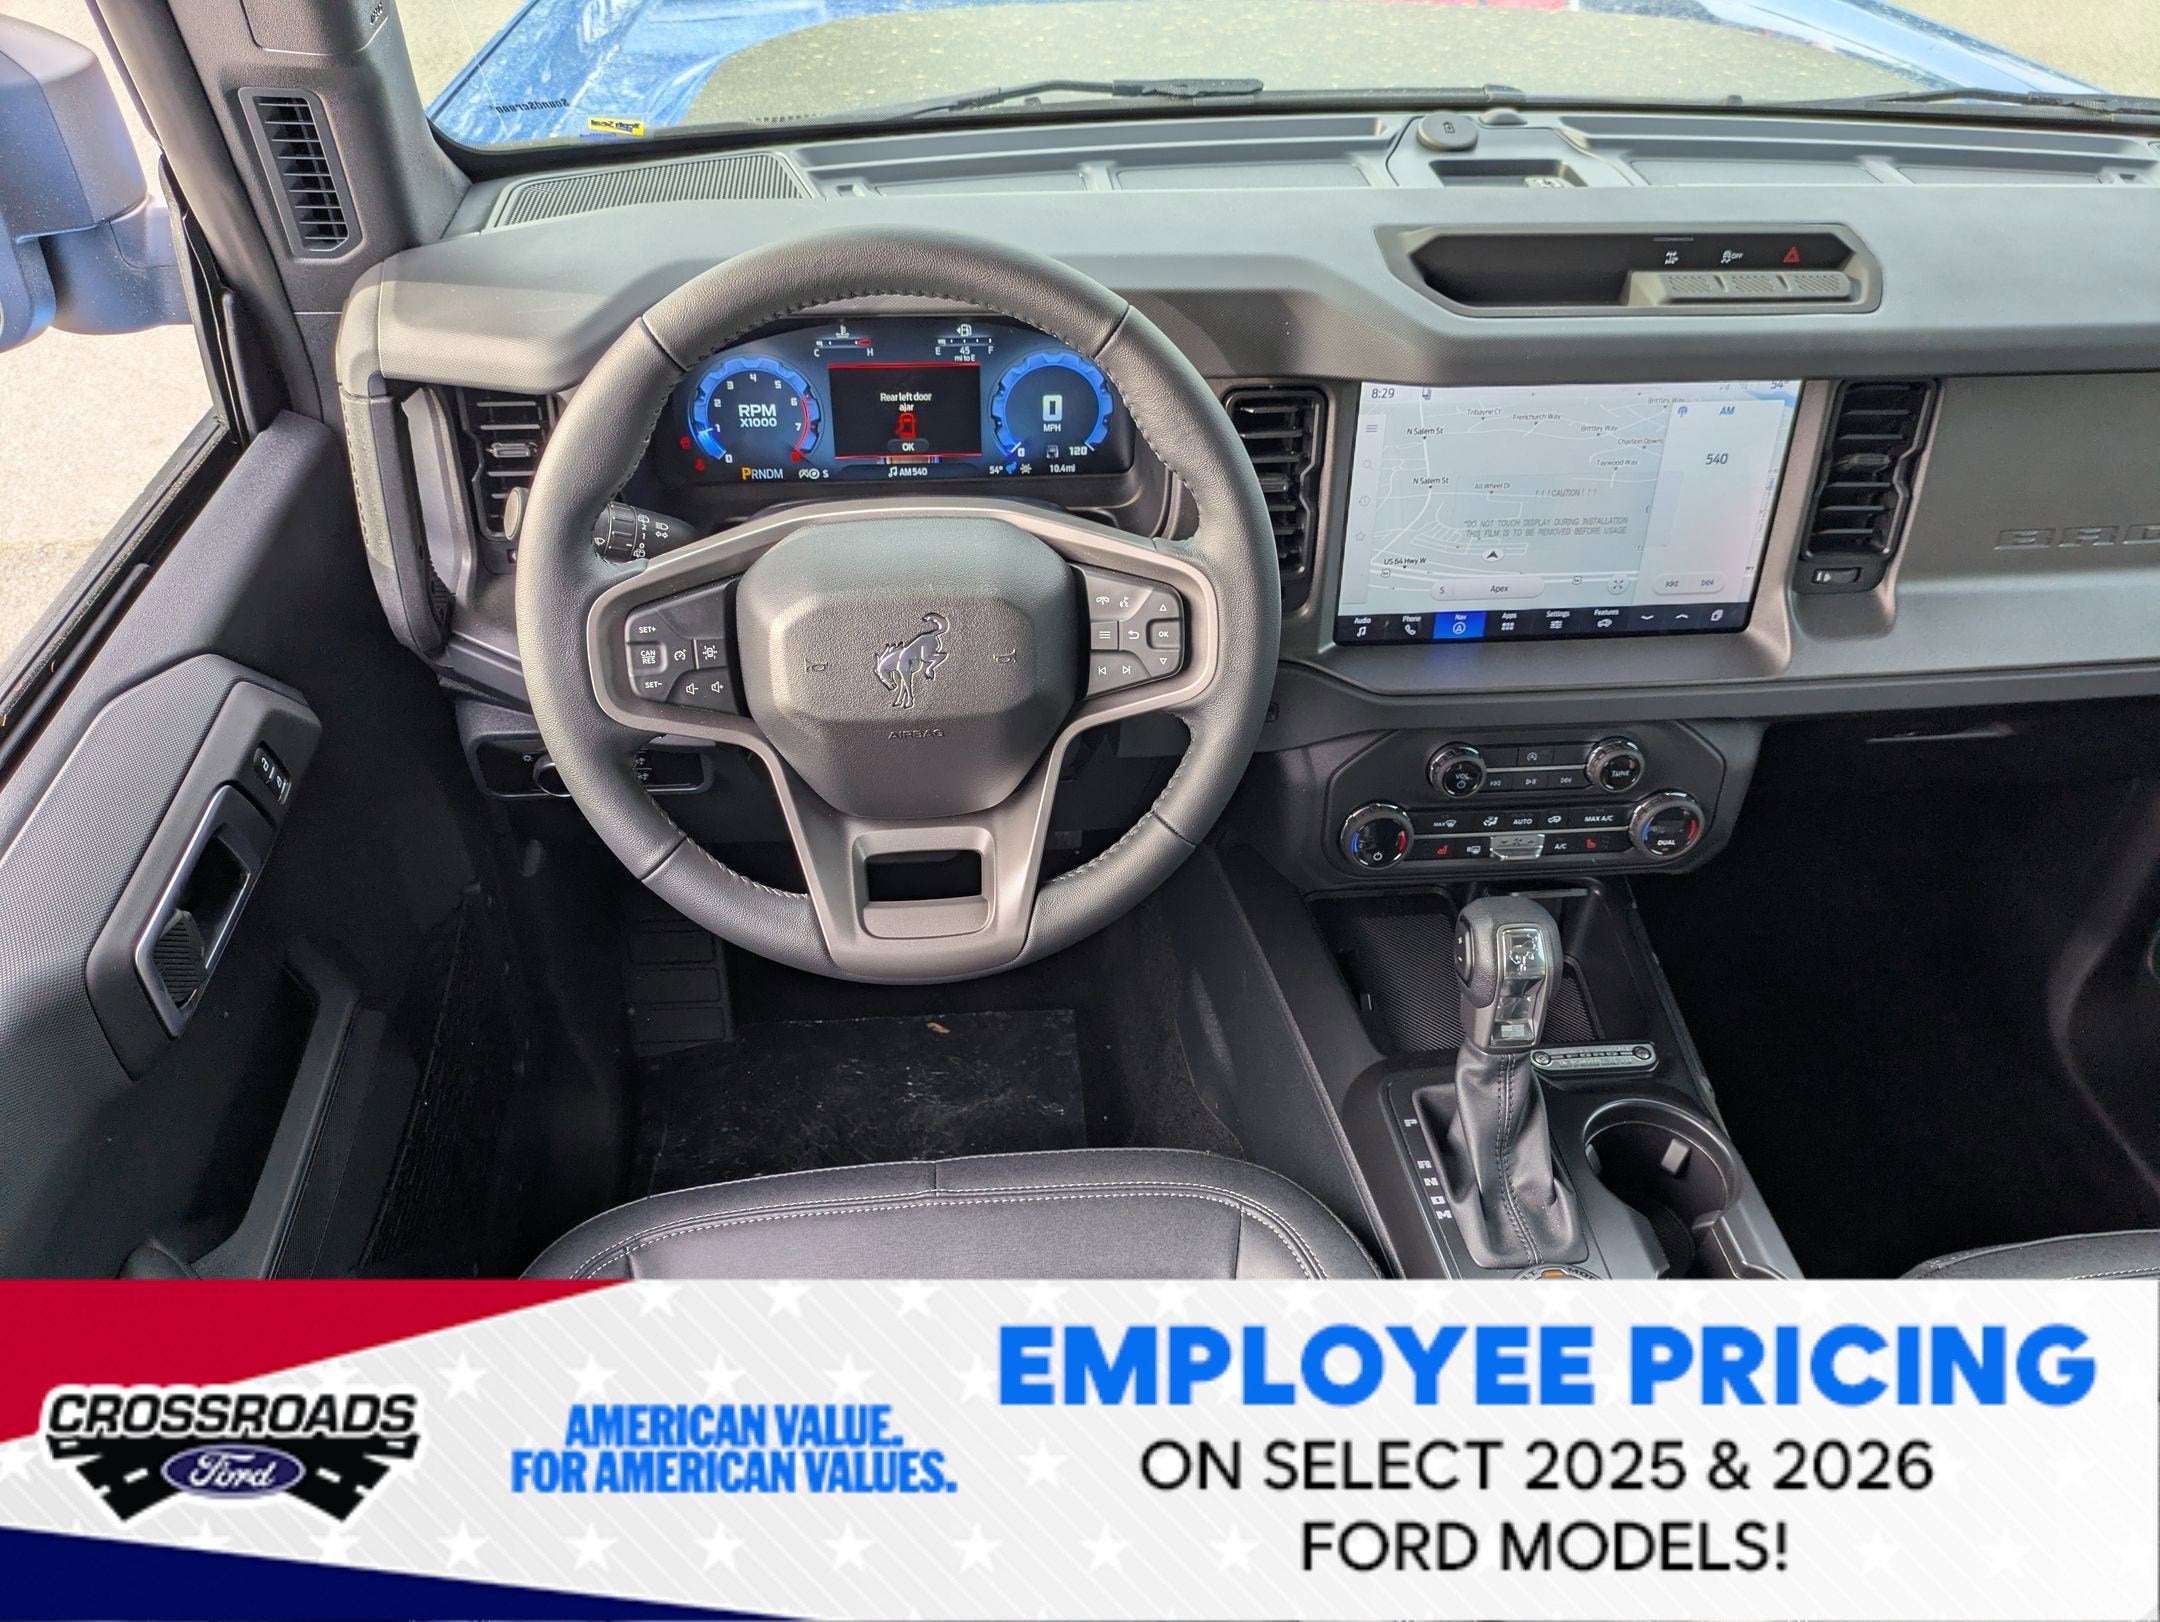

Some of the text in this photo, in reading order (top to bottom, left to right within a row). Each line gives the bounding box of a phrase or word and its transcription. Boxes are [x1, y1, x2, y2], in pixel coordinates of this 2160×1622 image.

[813, 348, 820, 358] C
[866, 348, 874, 357] H
[935, 346, 941, 355] E
[959, 346, 971, 355] 45
[988, 346, 994, 354] F
[750, 373, 757, 382] 4
[726, 381, 735, 390] 3
[774, 380, 782, 389] 5
[880, 391, 932, 402] Rear left door
[1371, 388, 1395, 400] 8:29
[713, 398, 722, 407] 2
[790, 398, 798, 406] 6
[738, 403, 777, 418] RPM
[899, 403, 915, 413] ajar
[1042, 394, 1063, 422] 0
[1719, 406, 1735, 416] AM
[739, 418, 778, 428] X1000
[794, 422, 802, 431] 7
[1043, 424, 1062, 433] MPH
[1407, 427, 1444, 435] N Salem St
[901, 442, 915, 452] OK
[1068, 446, 1088, 456] 120
[1017, 448, 1025, 457] 0
[725, 454, 733, 463] 0
[1705, 453, 1729, 465] 540
[822, 469, 829, 478] S
[912, 467, 928, 476] 540
[1413, 477, 1449, 485] N Salem St
[1490, 585, 1509, 594] Apex
[1501, 612, 1518, 620] Apps
[1546, 610, 1570, 619] Settings
[1594, 608, 1620, 616] Features
[1354, 616, 1371, 625] Audio
[1402, 615, 1422, 623] Phone
[1454, 613, 1468, 621] Nav
[1158, 630, 1169, 638] OK
[640, 650, 656, 658] CAN
[641, 657, 656, 665] RES
[888, 729, 944, 740] AIRBAG
[1404, 1119, 1418, 1127] P
[1417, 1160, 1432, 1169] R
[1424, 1177, 1439, 1186] N
[1430, 1195, 1446, 1205] D
[1436, 1209, 1452, 1219] M
